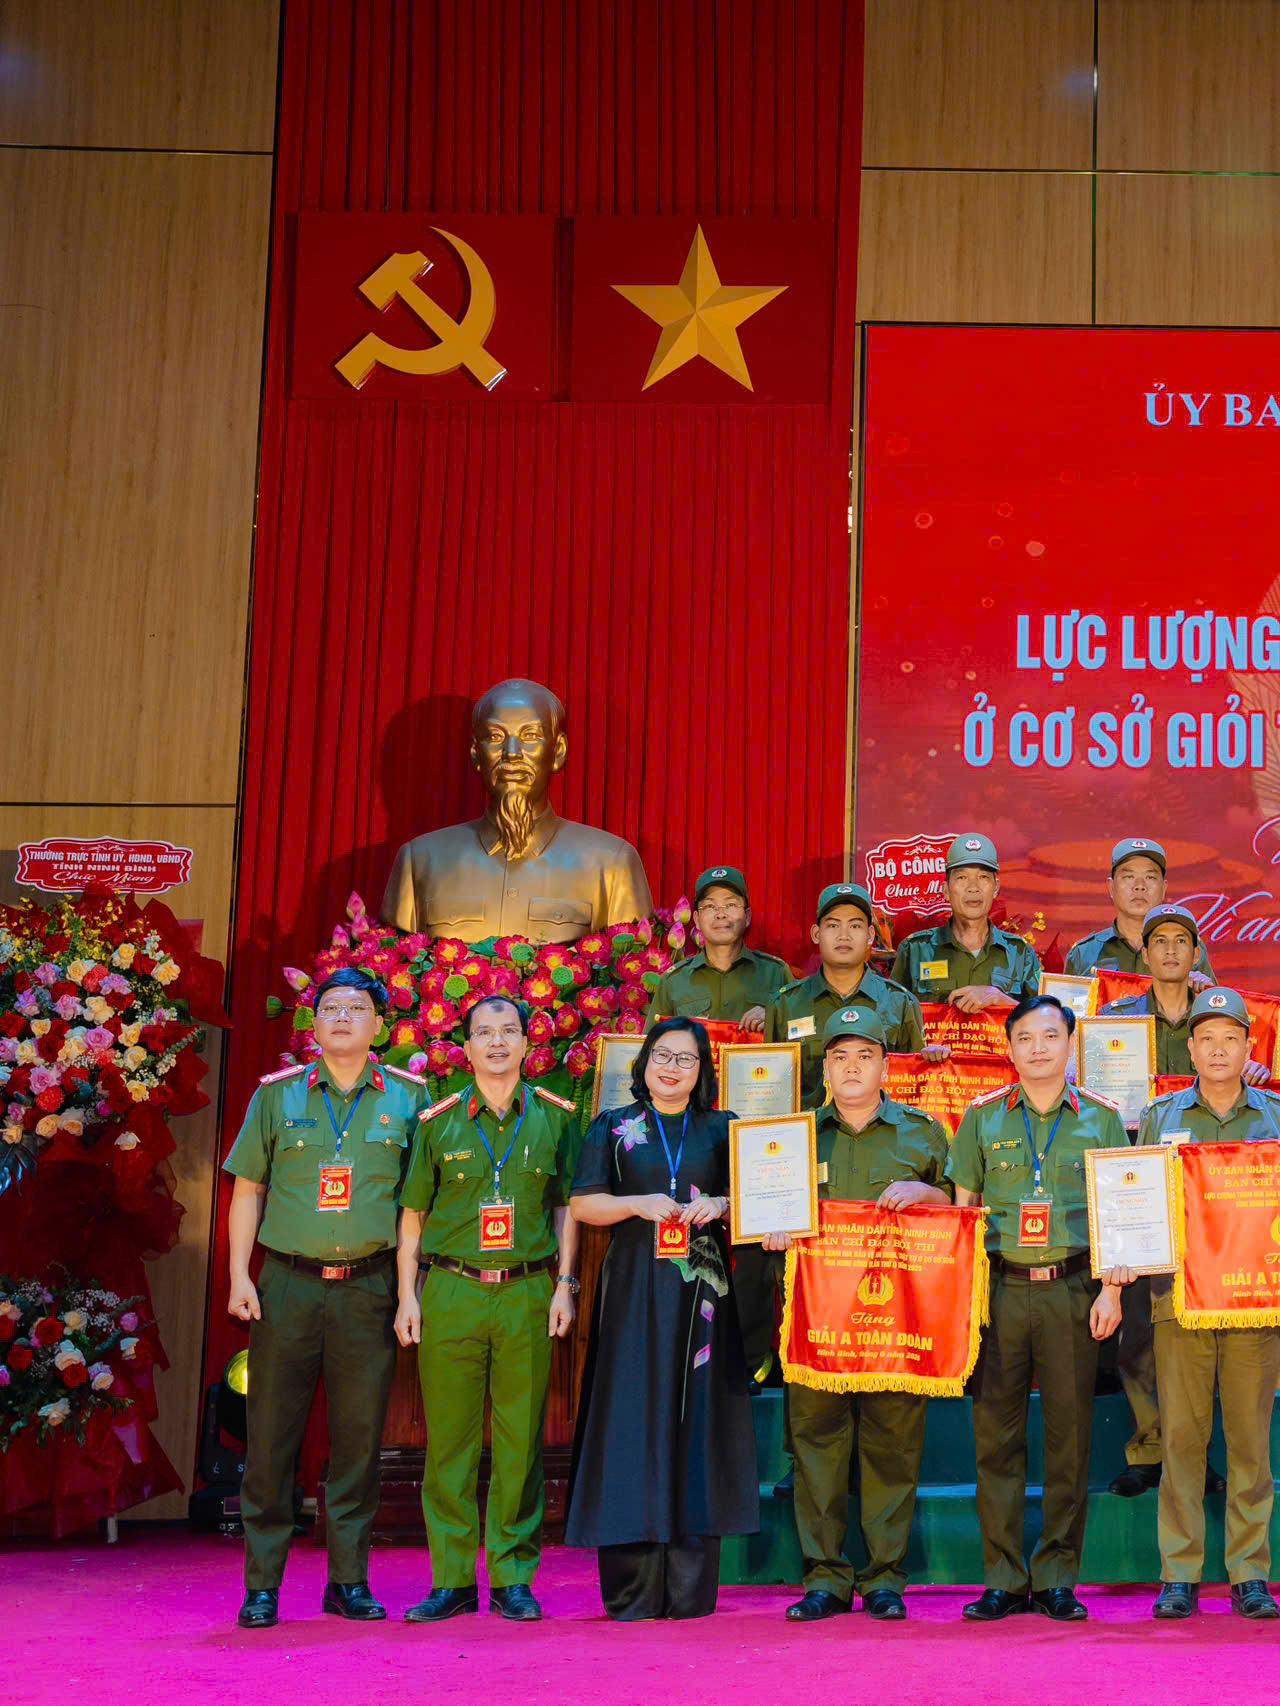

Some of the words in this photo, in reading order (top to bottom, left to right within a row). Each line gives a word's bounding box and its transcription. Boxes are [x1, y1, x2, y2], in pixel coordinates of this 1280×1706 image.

[1144, 382, 1211, 428] ỦY
[1016, 608, 1109, 683] LỰC
[962, 691, 997, 769] Ở
[1007, 706, 1077, 769] CƠ
[1086, 692, 1155, 769] SỞ
[1165, 692, 1266, 769] GIỎI
[874, 858, 897, 880] BỘ
[900, 855, 947, 877] CÔNG
[884, 883, 920, 898] Chúc
[818, 1223, 835, 1234] AN
[1256, 1270, 1268, 1286] A
[850, 1311, 896, 1327] Tặng
[807, 1325, 837, 1345] GIẢI
[839, 1330, 852, 1345] A
[855, 1328, 893, 1345] TOÀN
[895, 1332, 933, 1351] ĐOÀN
